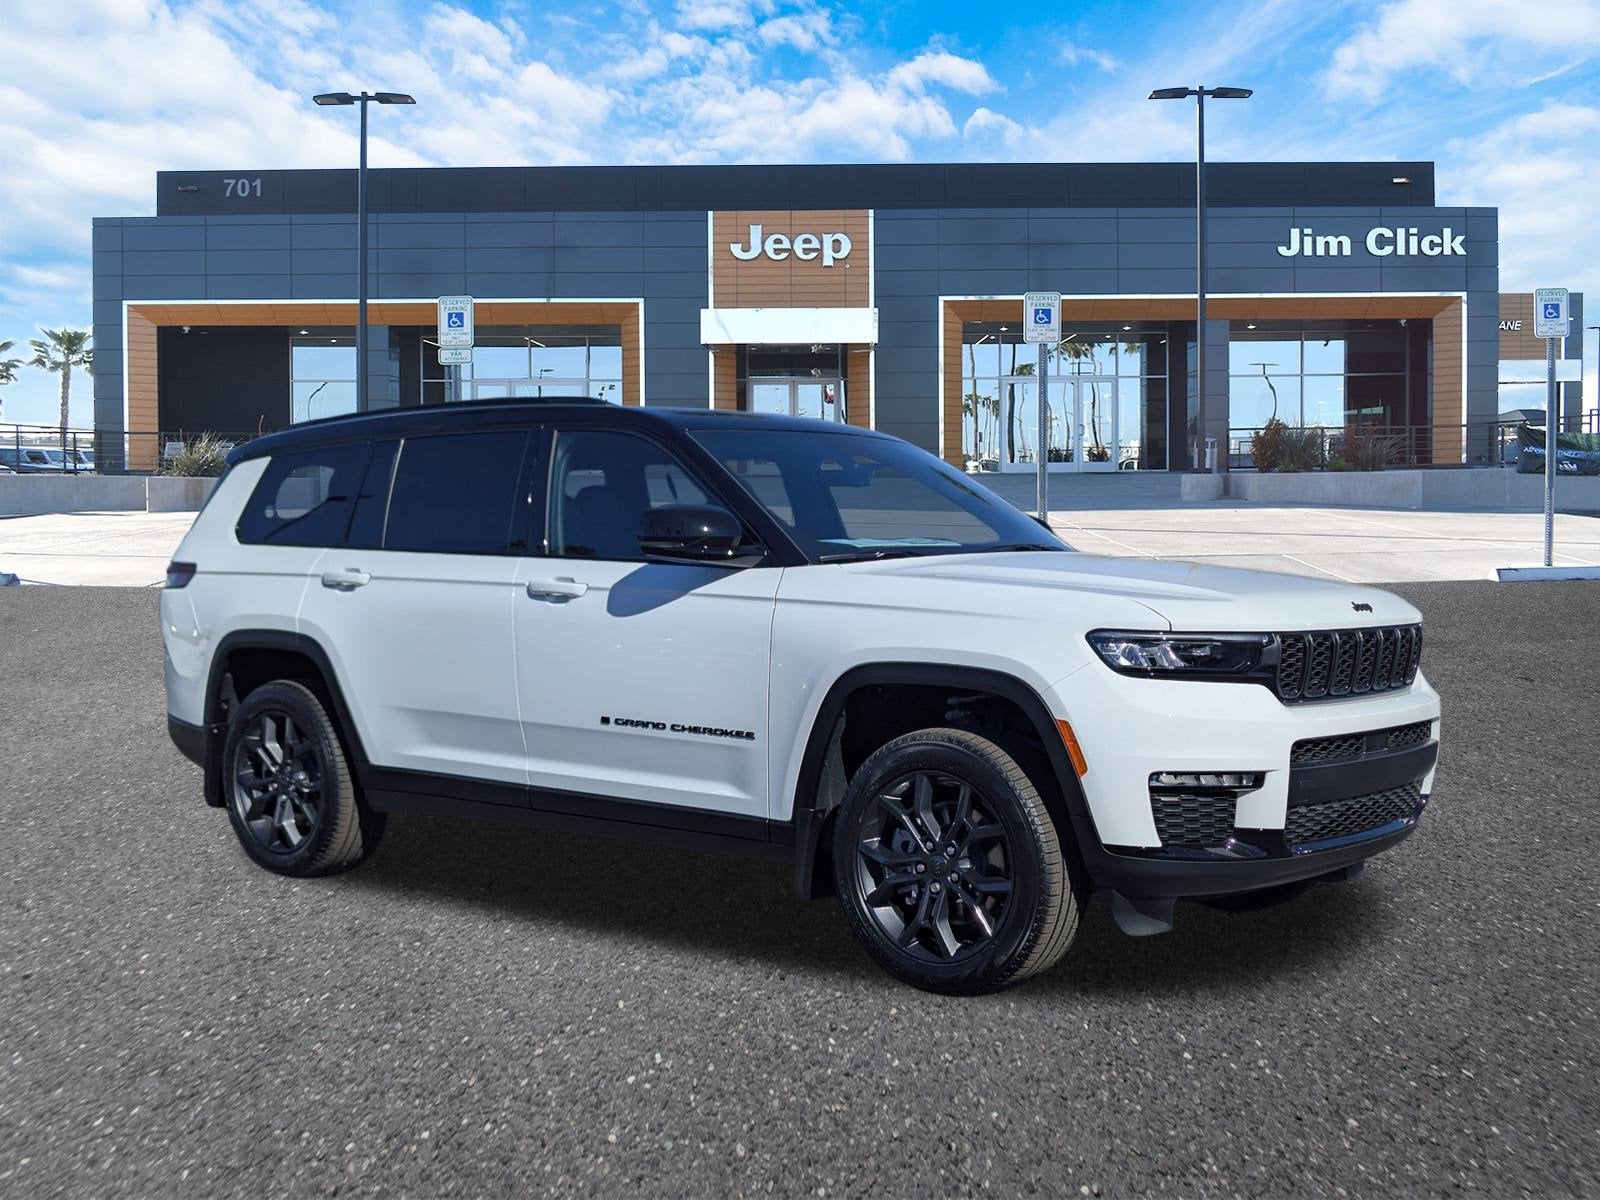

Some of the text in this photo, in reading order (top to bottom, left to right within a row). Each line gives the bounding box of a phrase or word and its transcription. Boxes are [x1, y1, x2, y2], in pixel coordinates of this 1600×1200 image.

[224, 178, 261, 197] 701
[730, 223, 852, 267] Jeep
[1277, 227, 1467, 257] Jim Click
[614, 717, 756, 741] GRAND CHEROKEE
